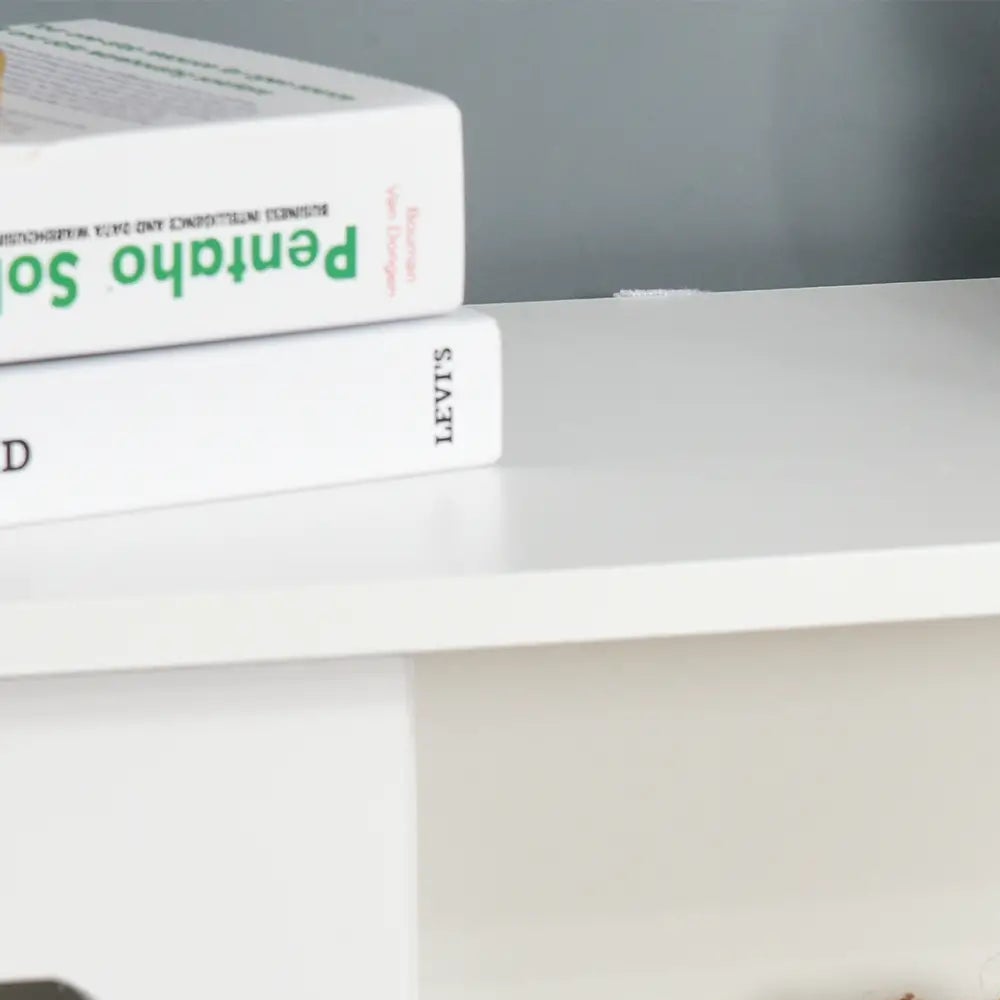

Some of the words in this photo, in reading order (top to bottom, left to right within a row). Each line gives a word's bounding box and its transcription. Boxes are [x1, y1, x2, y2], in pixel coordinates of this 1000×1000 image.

[265, 203, 329, 224] BUSINESS
[94, 221, 131, 238] DATA
[136, 218, 165, 235] AND
[110, 225, 357, 299] Pentaho
[434, 347, 452, 445] LEVI'S
